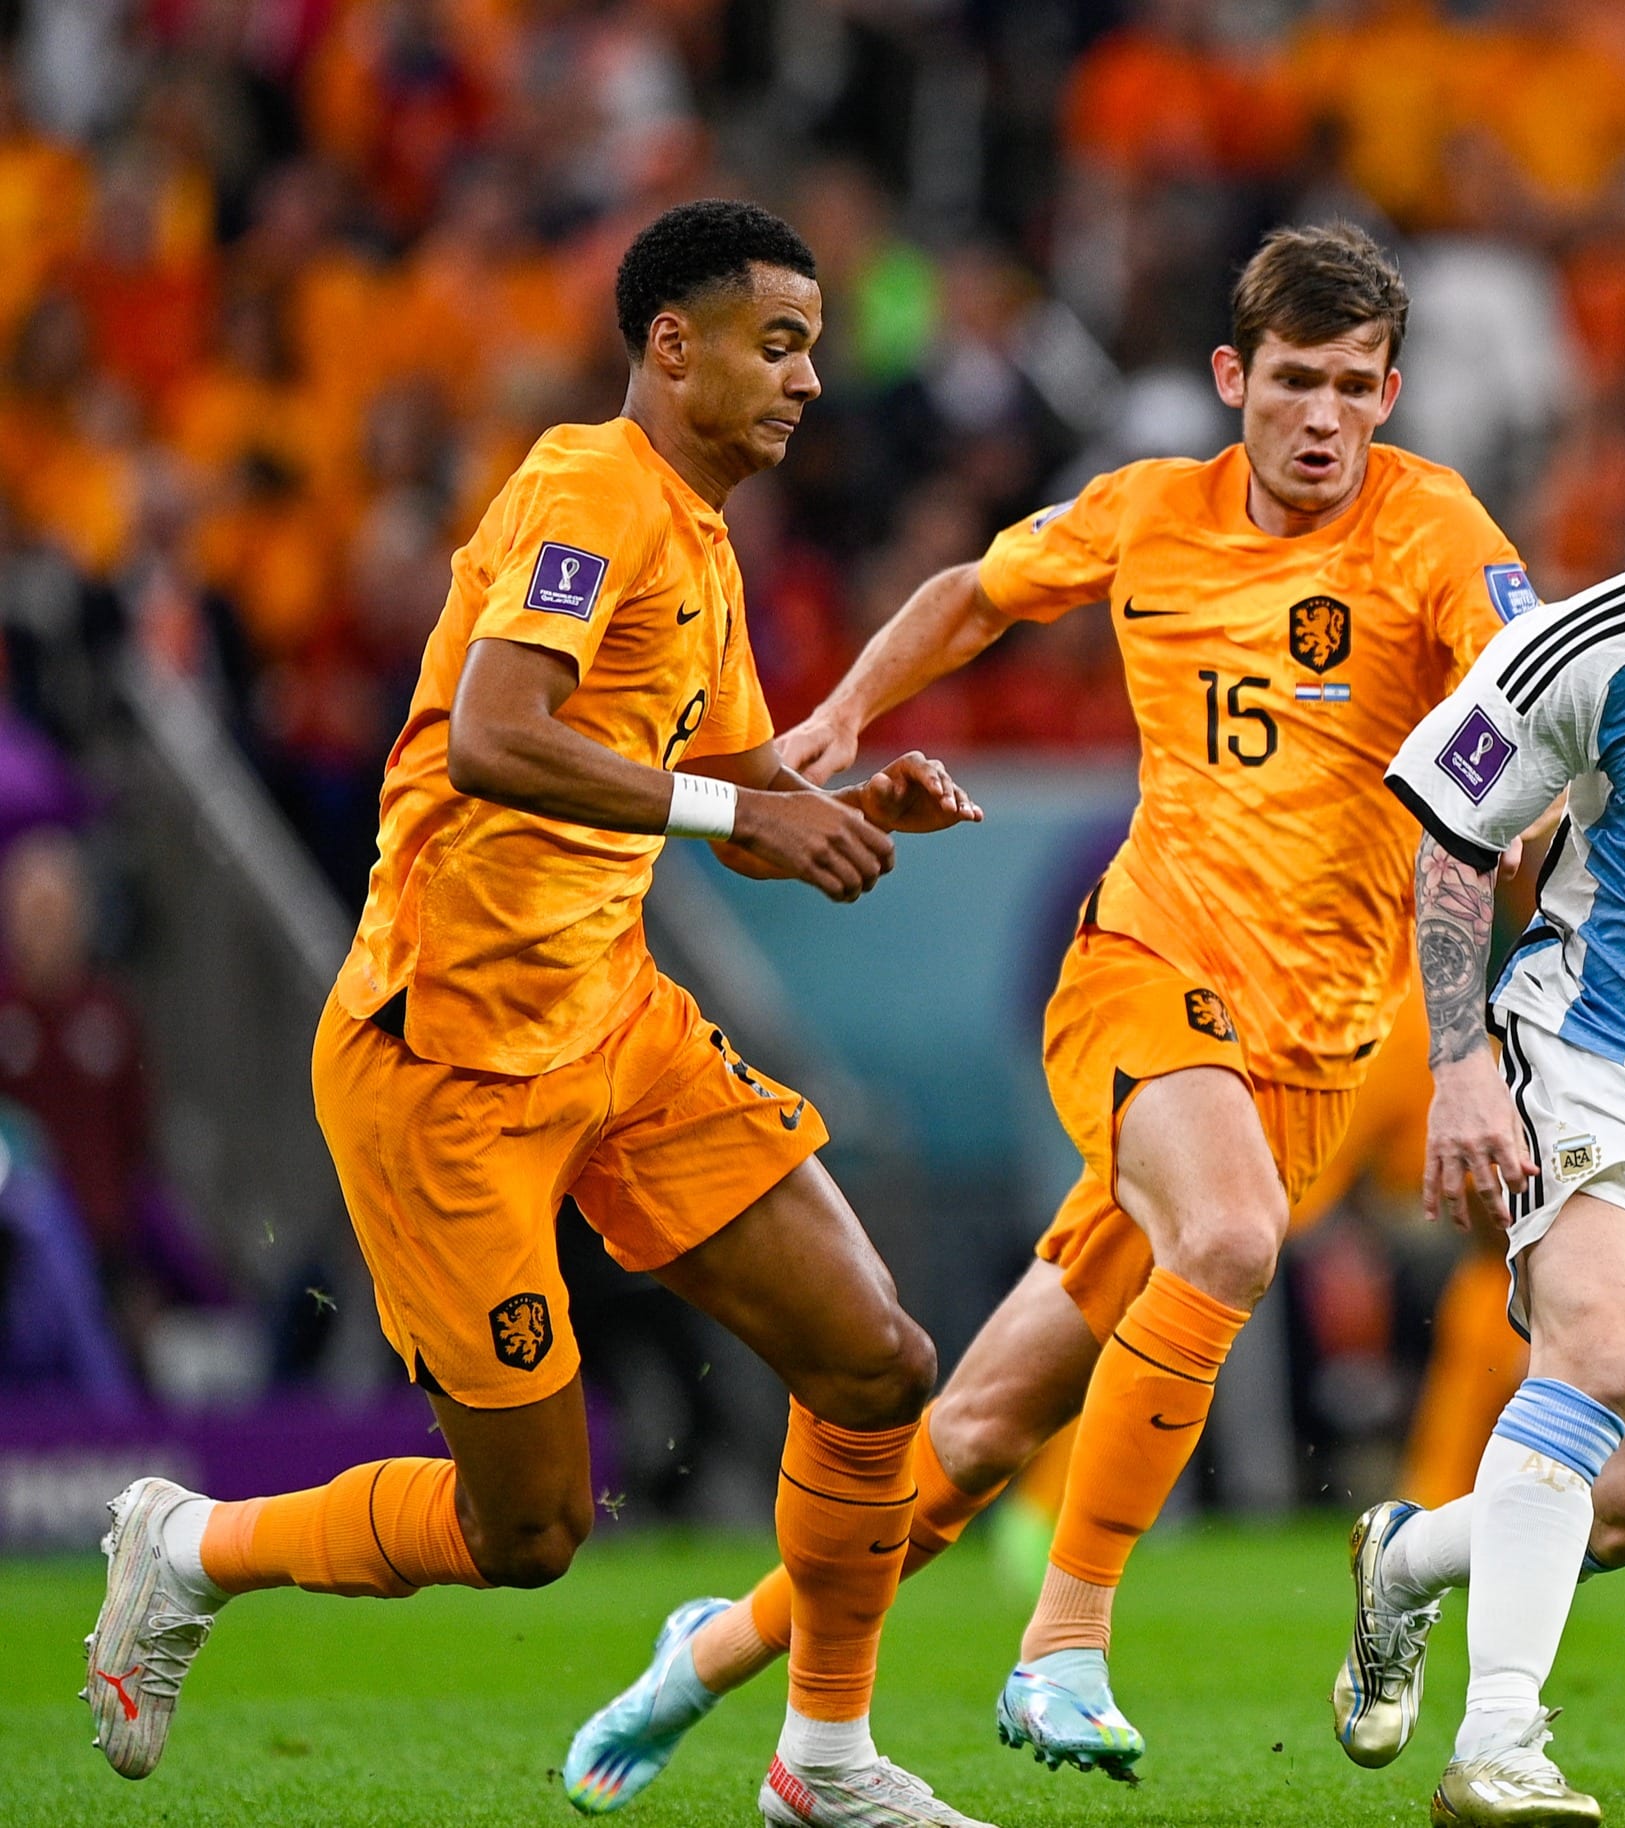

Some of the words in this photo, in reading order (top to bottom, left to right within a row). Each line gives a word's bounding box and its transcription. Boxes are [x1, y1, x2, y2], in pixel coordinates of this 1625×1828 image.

[661, 688, 707, 772] 8
[1198, 669, 1278, 767] 15
[1563, 1146, 1591, 1169] AFA
